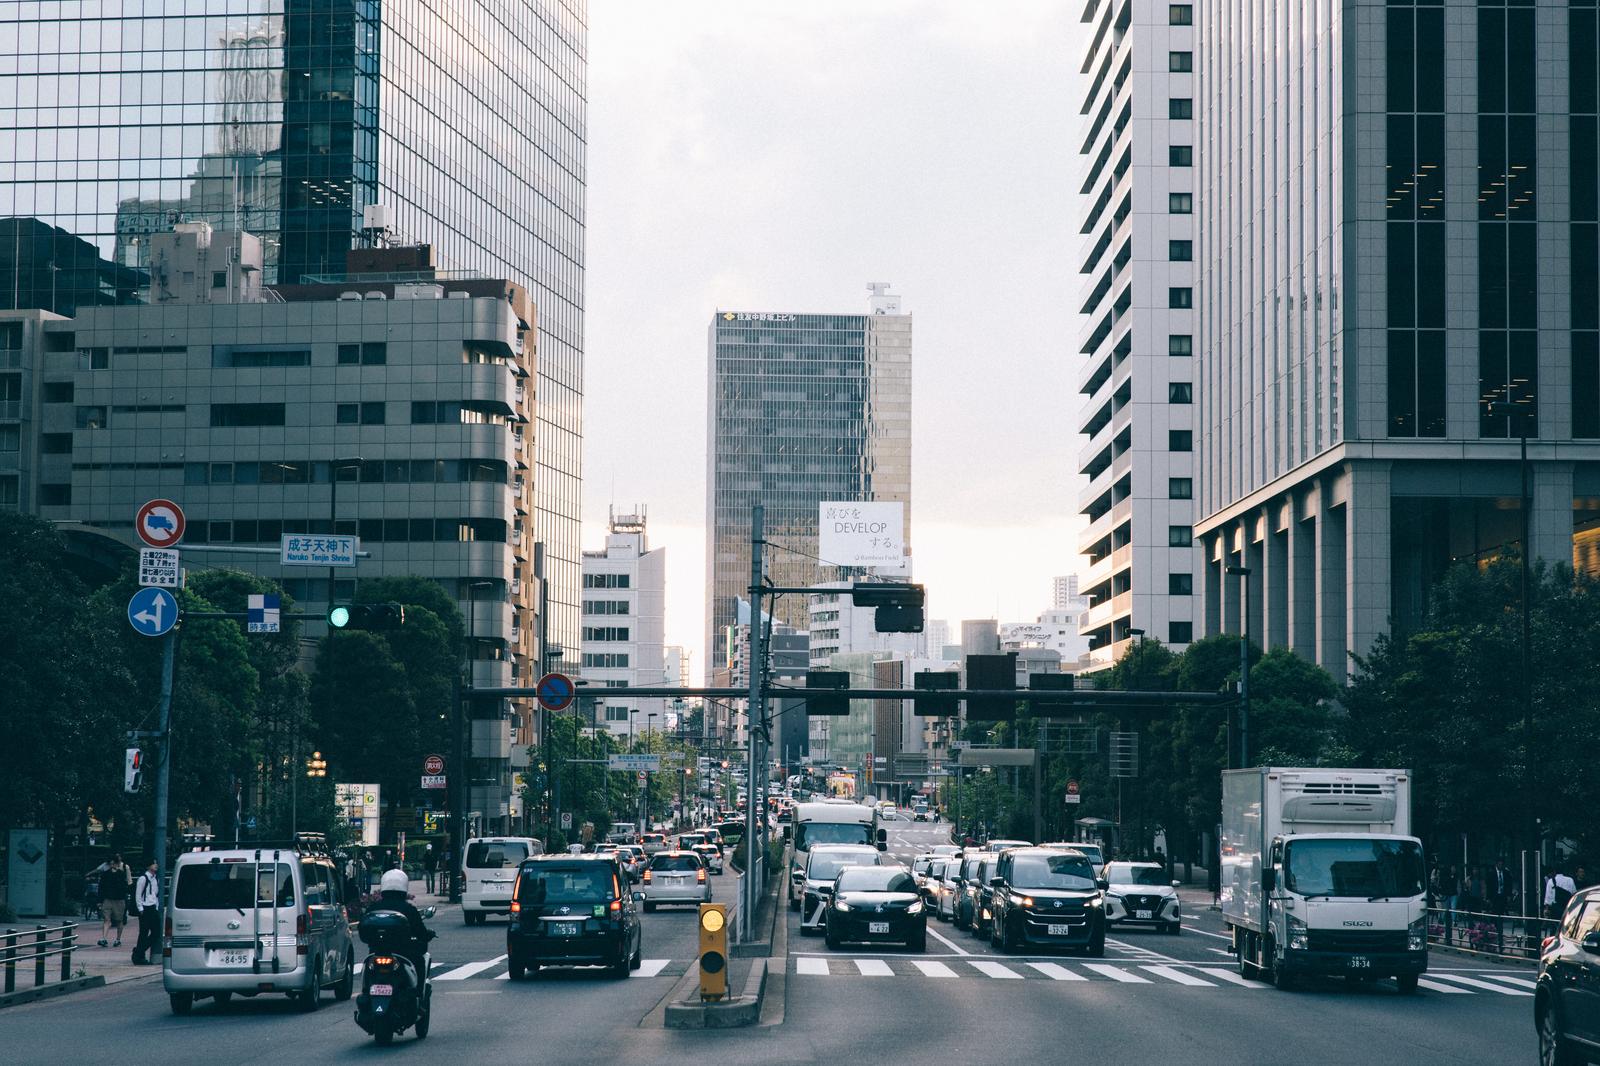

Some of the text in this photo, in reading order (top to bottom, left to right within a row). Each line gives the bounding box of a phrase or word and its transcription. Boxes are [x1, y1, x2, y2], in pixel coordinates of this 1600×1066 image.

[834, 522, 887, 534] DEVELOP
[288, 538, 350, 553] 成子天神下
[287, 553, 350, 562] Naruko Tenjin Shrine
